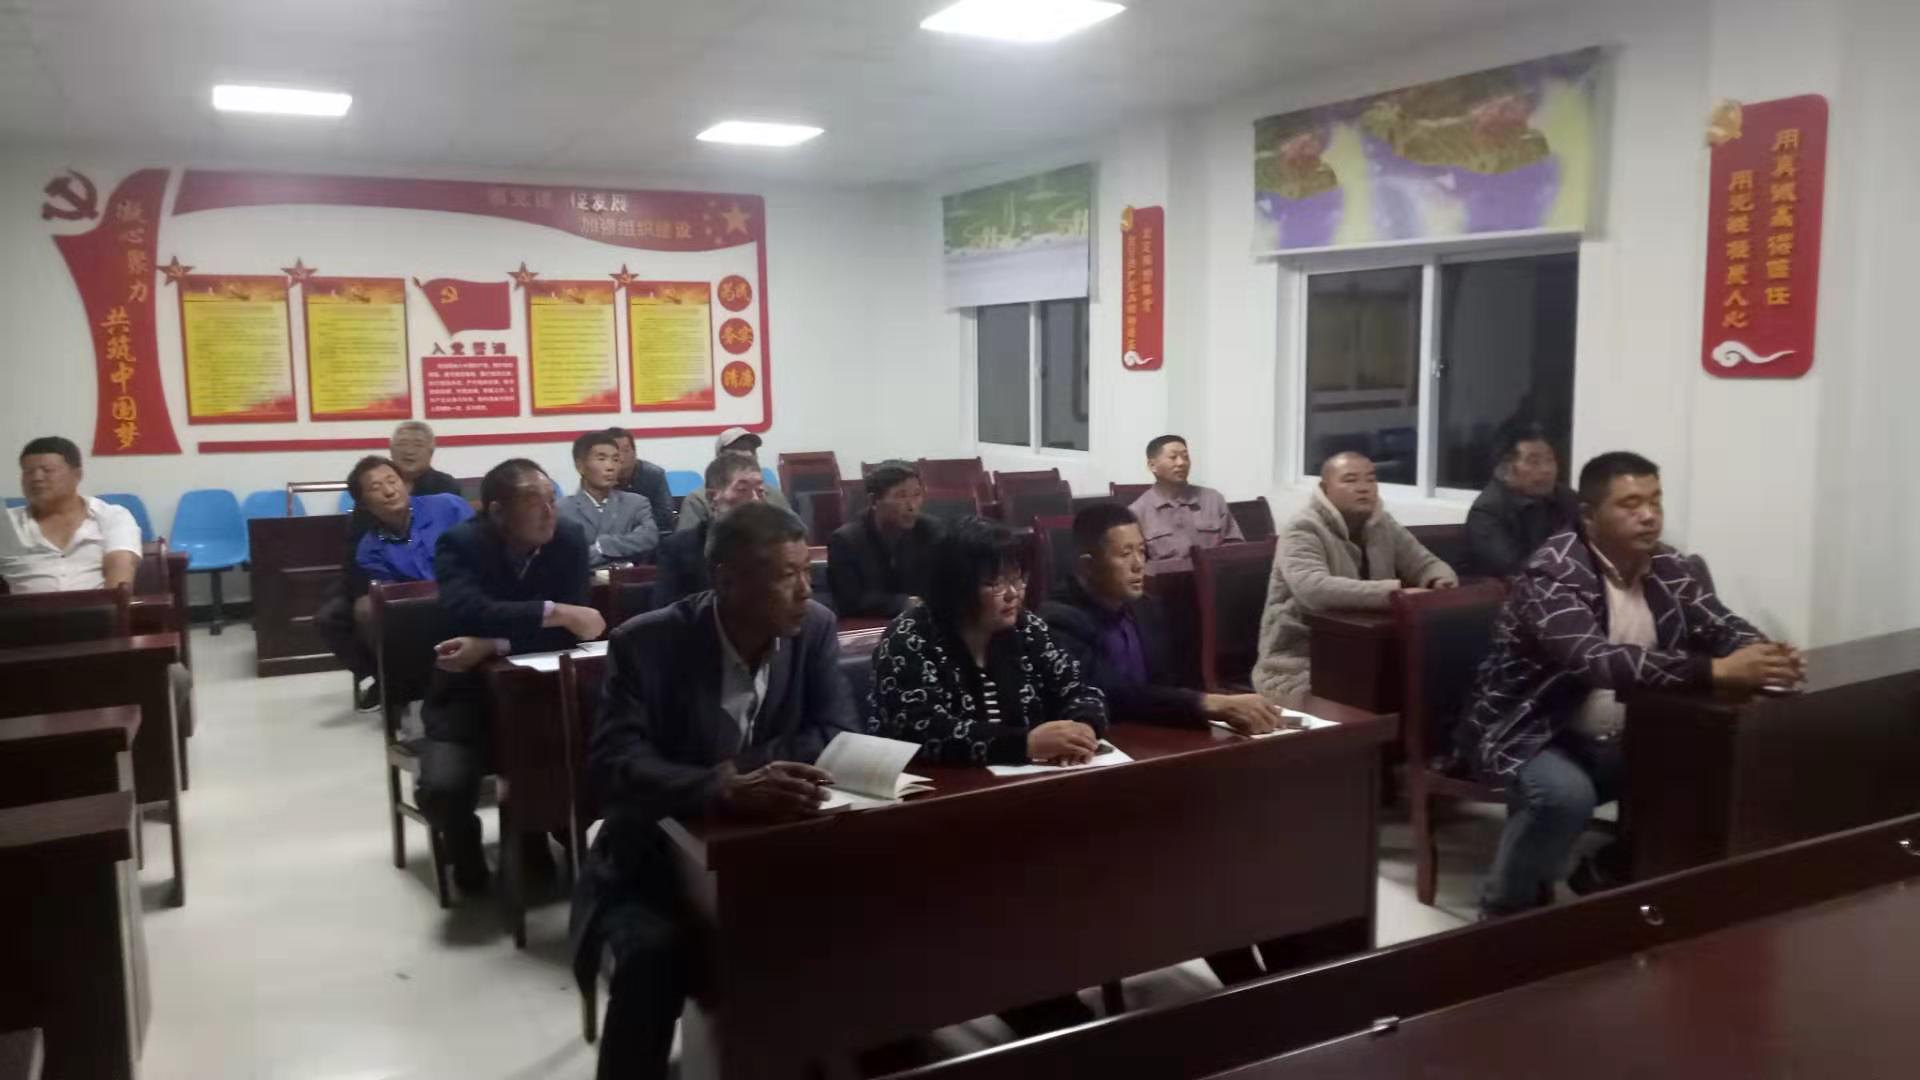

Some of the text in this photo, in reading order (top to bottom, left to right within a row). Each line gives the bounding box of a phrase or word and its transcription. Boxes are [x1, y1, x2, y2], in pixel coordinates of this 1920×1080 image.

[100, 305, 140, 451] 共筑中国梦
